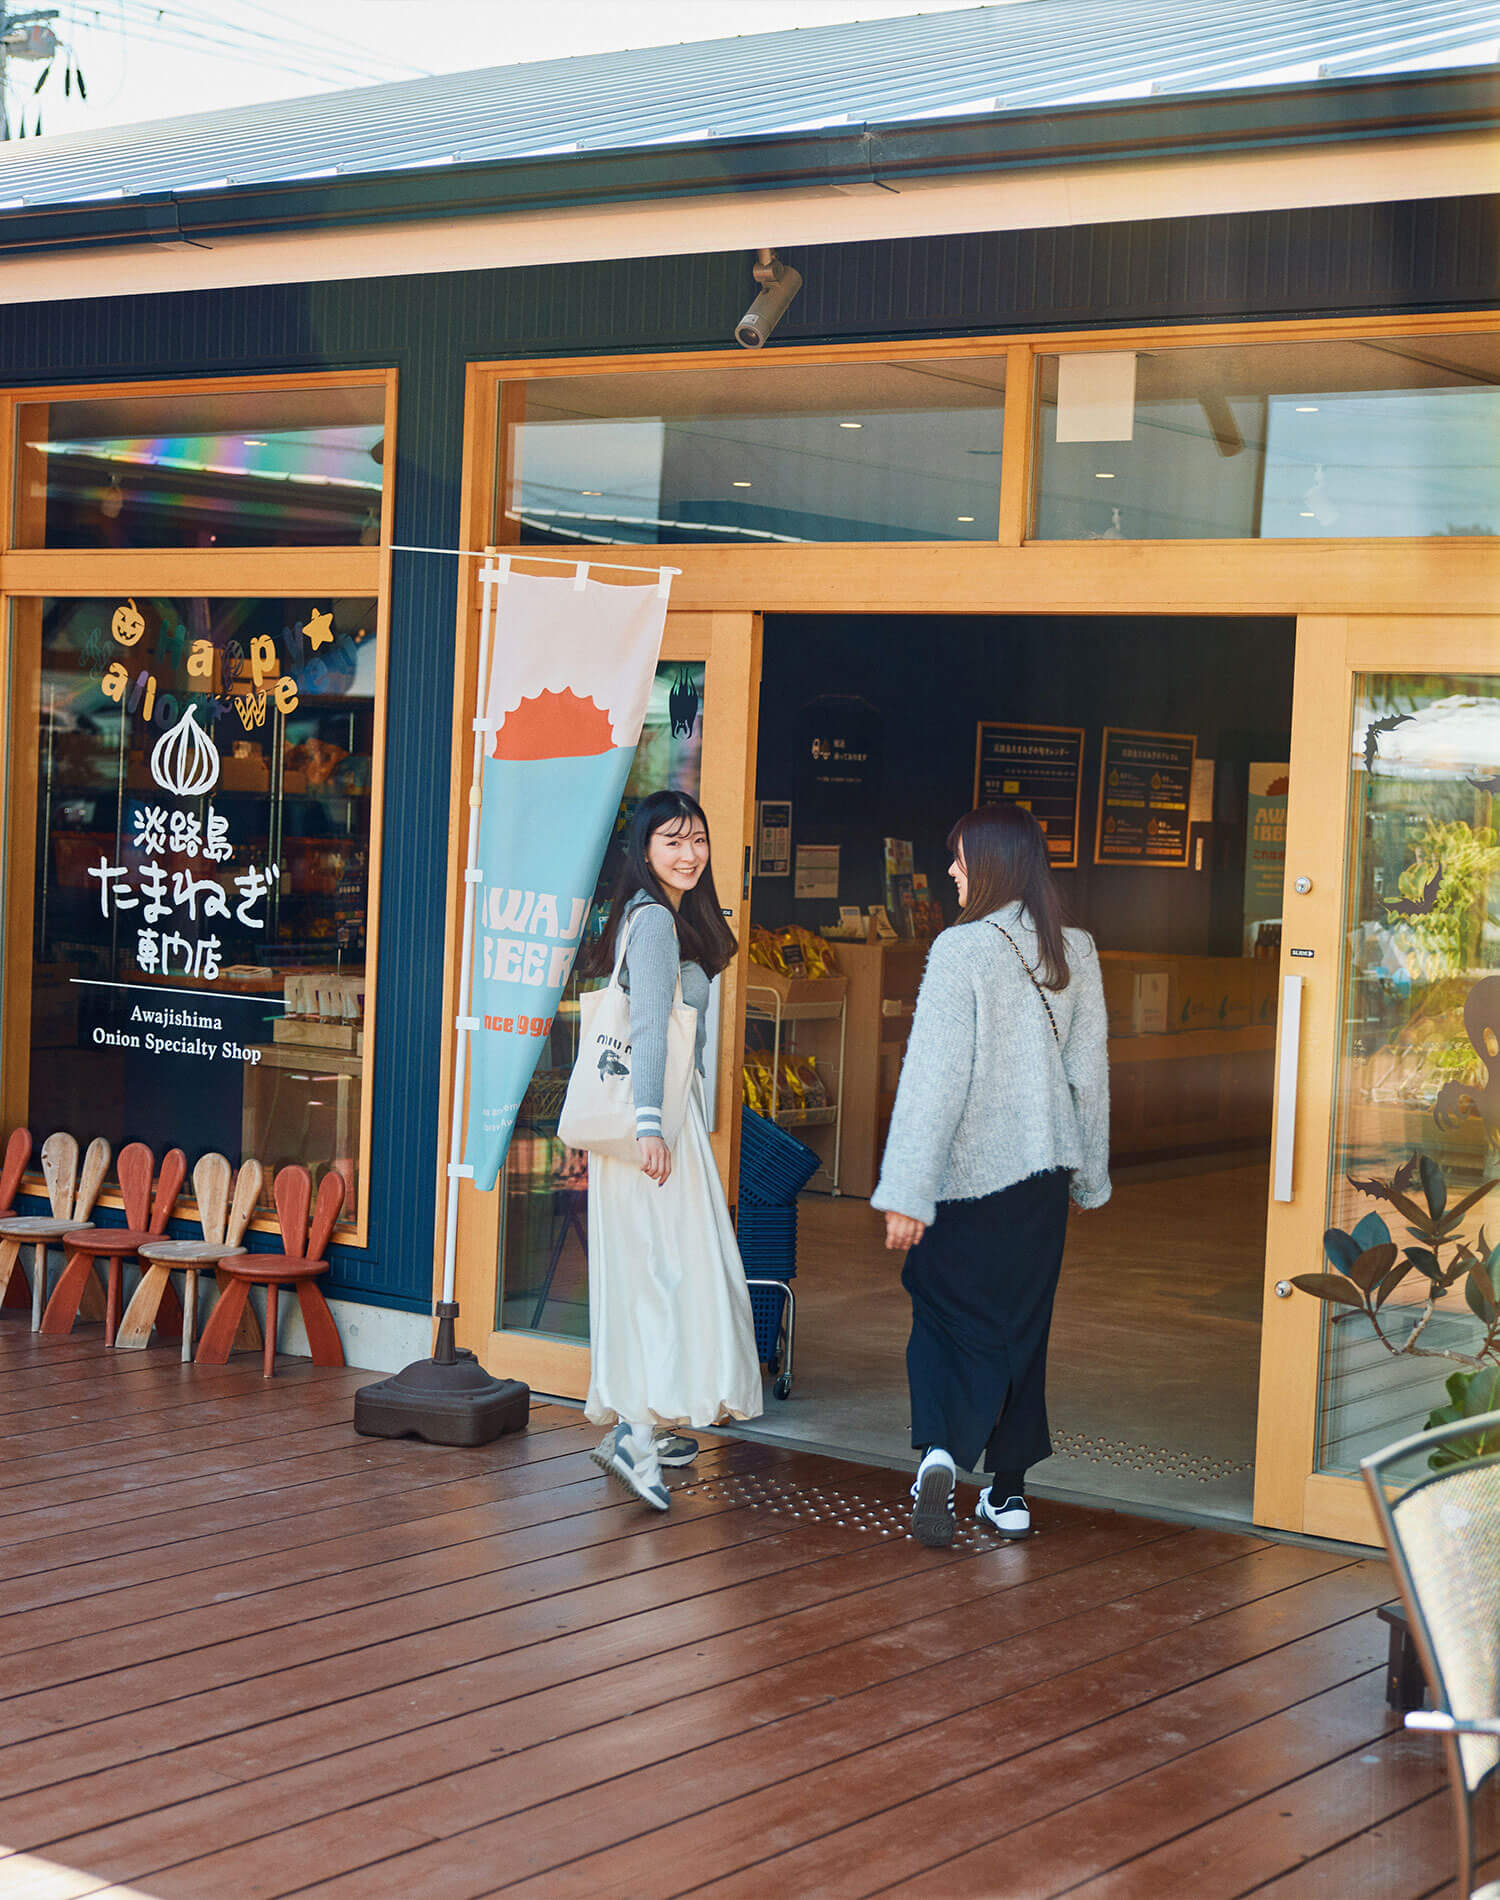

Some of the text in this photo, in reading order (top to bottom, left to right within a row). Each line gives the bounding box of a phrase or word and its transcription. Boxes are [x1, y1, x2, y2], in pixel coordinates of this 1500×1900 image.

[133, 805, 233, 863] 淡路島
[87, 855, 281, 929] たまねぎ
[481, 885, 592, 940] WAJ
[136, 927, 222, 981] 専門店
[130, 1005, 223, 1030] Awajishima
[92, 1027, 262, 1066] Onion Specialty Shop
